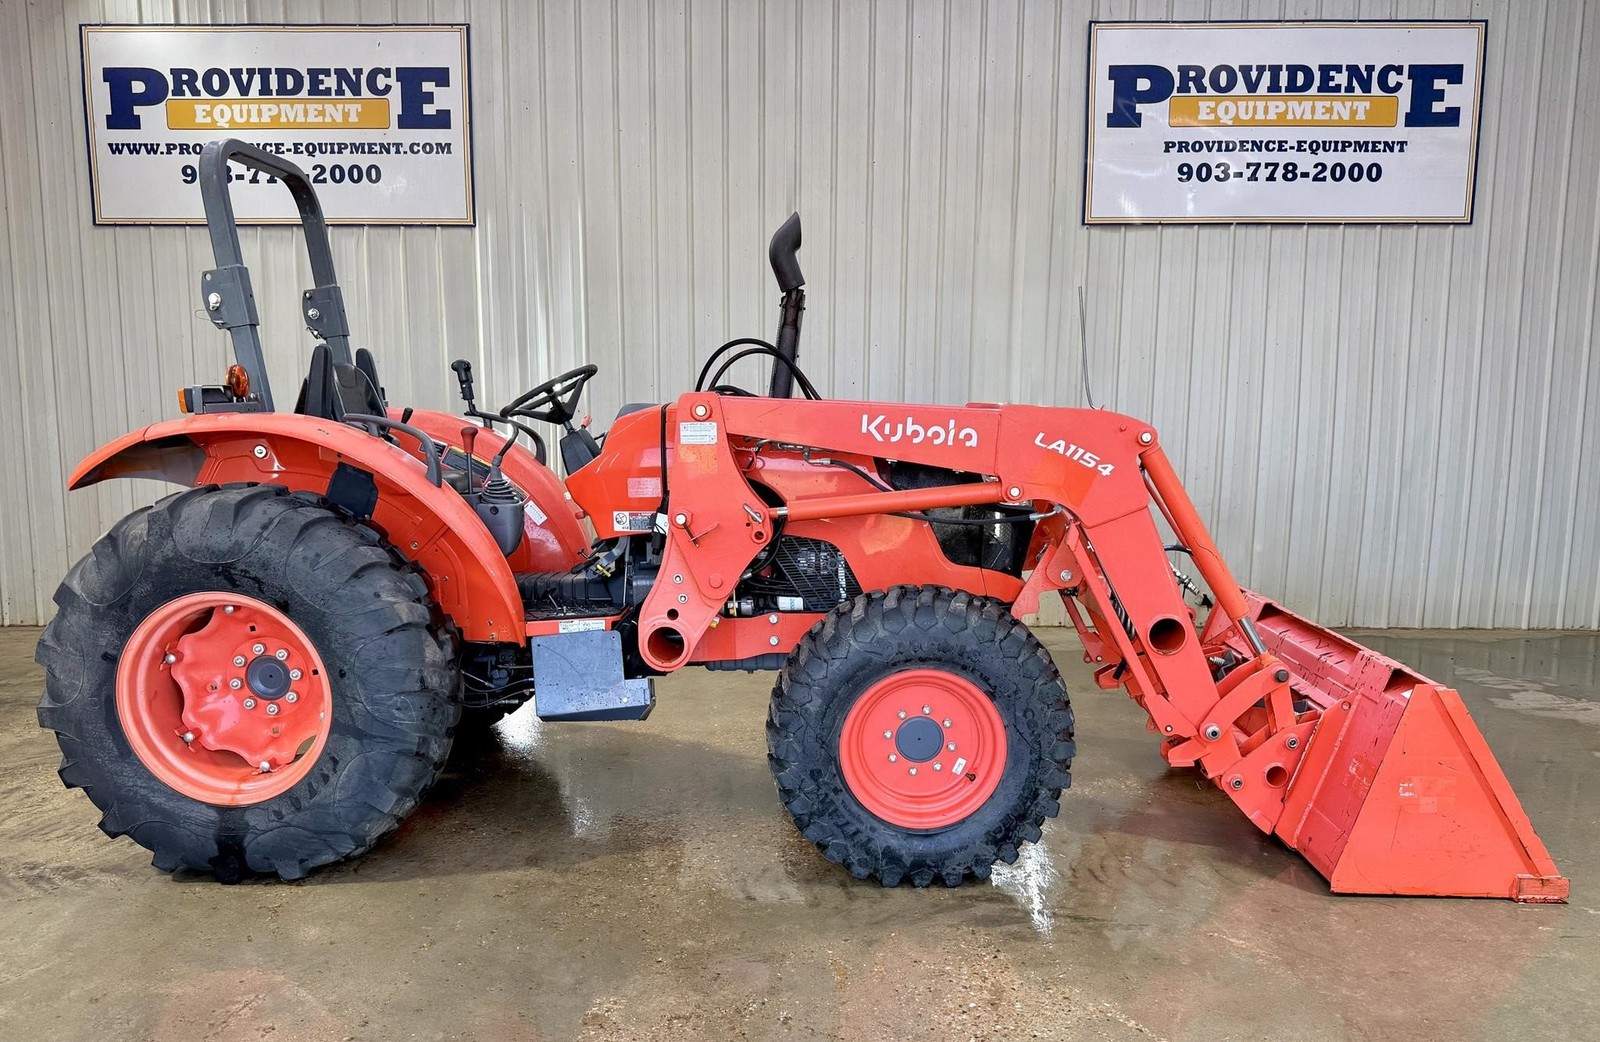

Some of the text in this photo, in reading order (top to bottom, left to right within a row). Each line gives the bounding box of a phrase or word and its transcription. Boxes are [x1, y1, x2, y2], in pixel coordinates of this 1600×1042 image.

[103, 67, 451, 130] PROVIDENCE
[1107, 64, 1463, 128] PROVIDENCE
[194, 103, 362, 128] EQUIPMENT
[1197, 100, 1371, 124] EQUIPMENT
[1163, 139, 1408, 155] PROVIDENCE-EQUIPMENT
[1177, 162, 1383, 183] 903-778-2000
[861, 414, 979, 447] Kubota
[1034, 432, 1116, 477] LA1154
